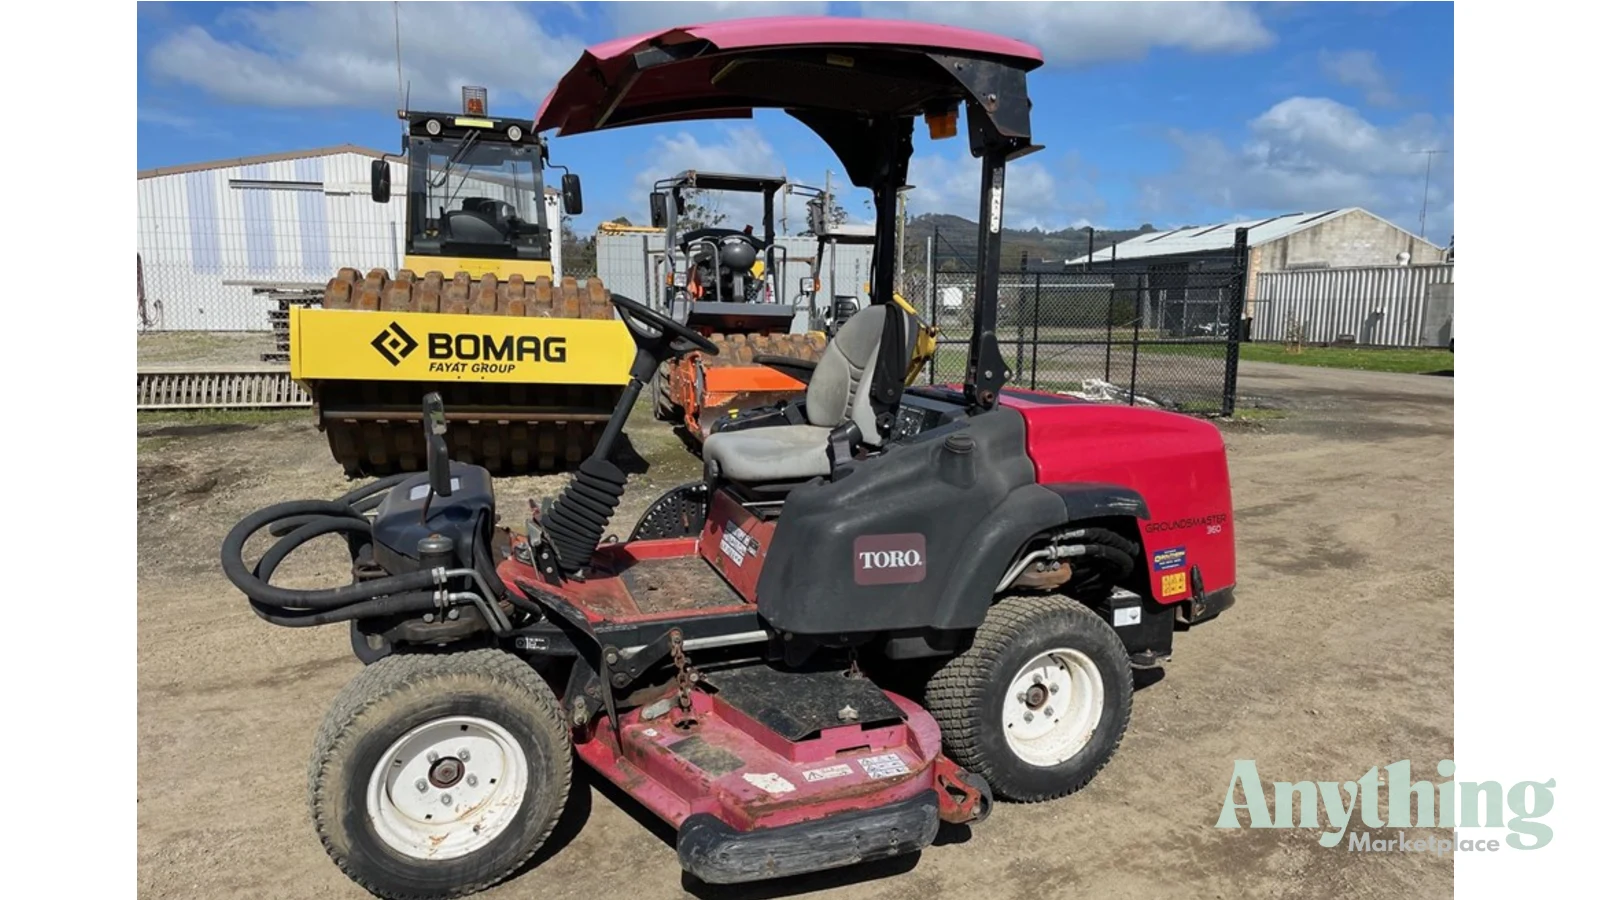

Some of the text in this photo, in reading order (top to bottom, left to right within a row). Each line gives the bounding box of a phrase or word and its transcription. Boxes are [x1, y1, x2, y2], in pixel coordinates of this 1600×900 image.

[428, 333, 566, 362] BOMAG
[429, 362, 516, 373] FAYAT GROUP
[1145, 514, 1227, 534] GROUNDSMASTER
[1206, 524, 1222, 535] 360
[859, 549, 920, 570] TORO
